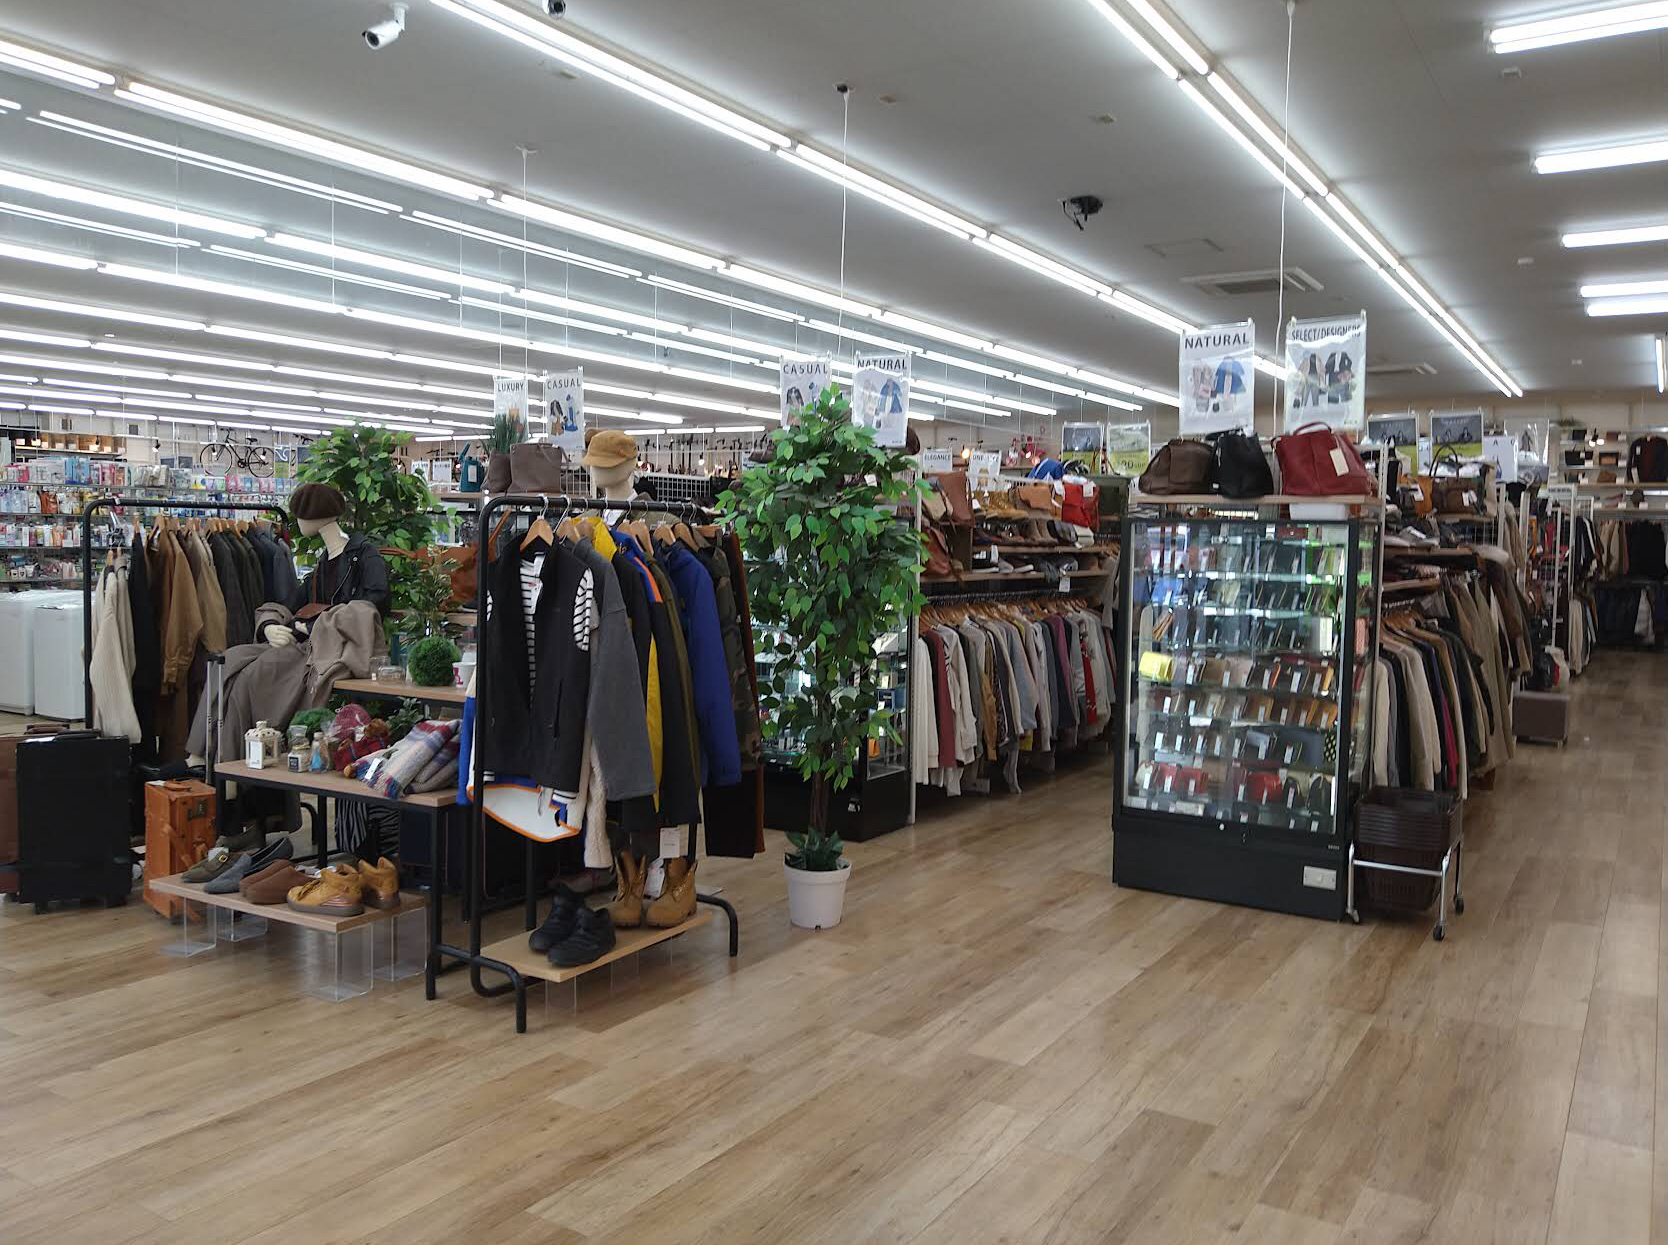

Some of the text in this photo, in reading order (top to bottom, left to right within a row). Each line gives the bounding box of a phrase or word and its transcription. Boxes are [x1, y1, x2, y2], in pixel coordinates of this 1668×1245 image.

[1184, 332, 1250, 350] NATURAL
[783, 363, 828, 375] CASUAL
[857, 358, 907, 371] NATURAL
[497, 382, 524, 392] LUXURY
[547, 378, 581, 390] CASUAL
[924, 453, 951, 462] ELEGANCE
